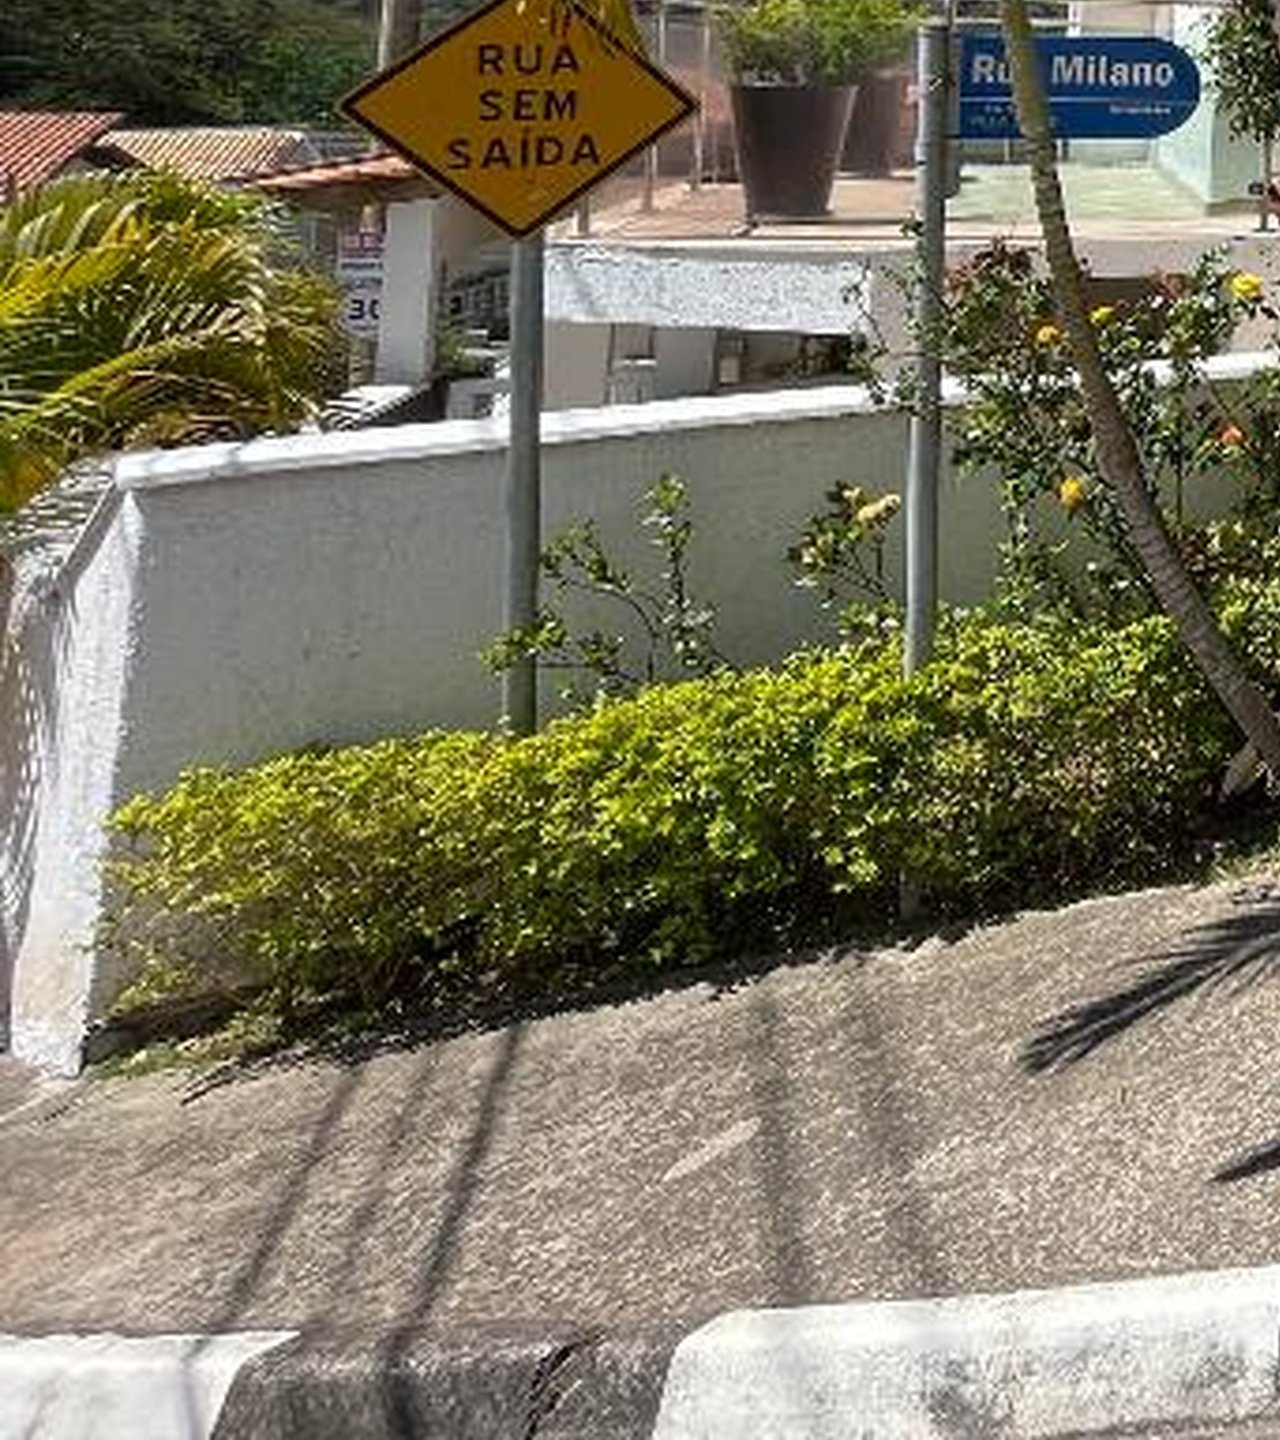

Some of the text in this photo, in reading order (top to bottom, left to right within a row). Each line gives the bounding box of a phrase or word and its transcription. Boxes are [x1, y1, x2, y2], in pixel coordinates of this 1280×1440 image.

[478, 45, 580, 75] RUA
[971, 54, 1174, 87] Ru Milano
[479, 90, 577, 122] SEM
[445, 129, 601, 171] SAÍDA
